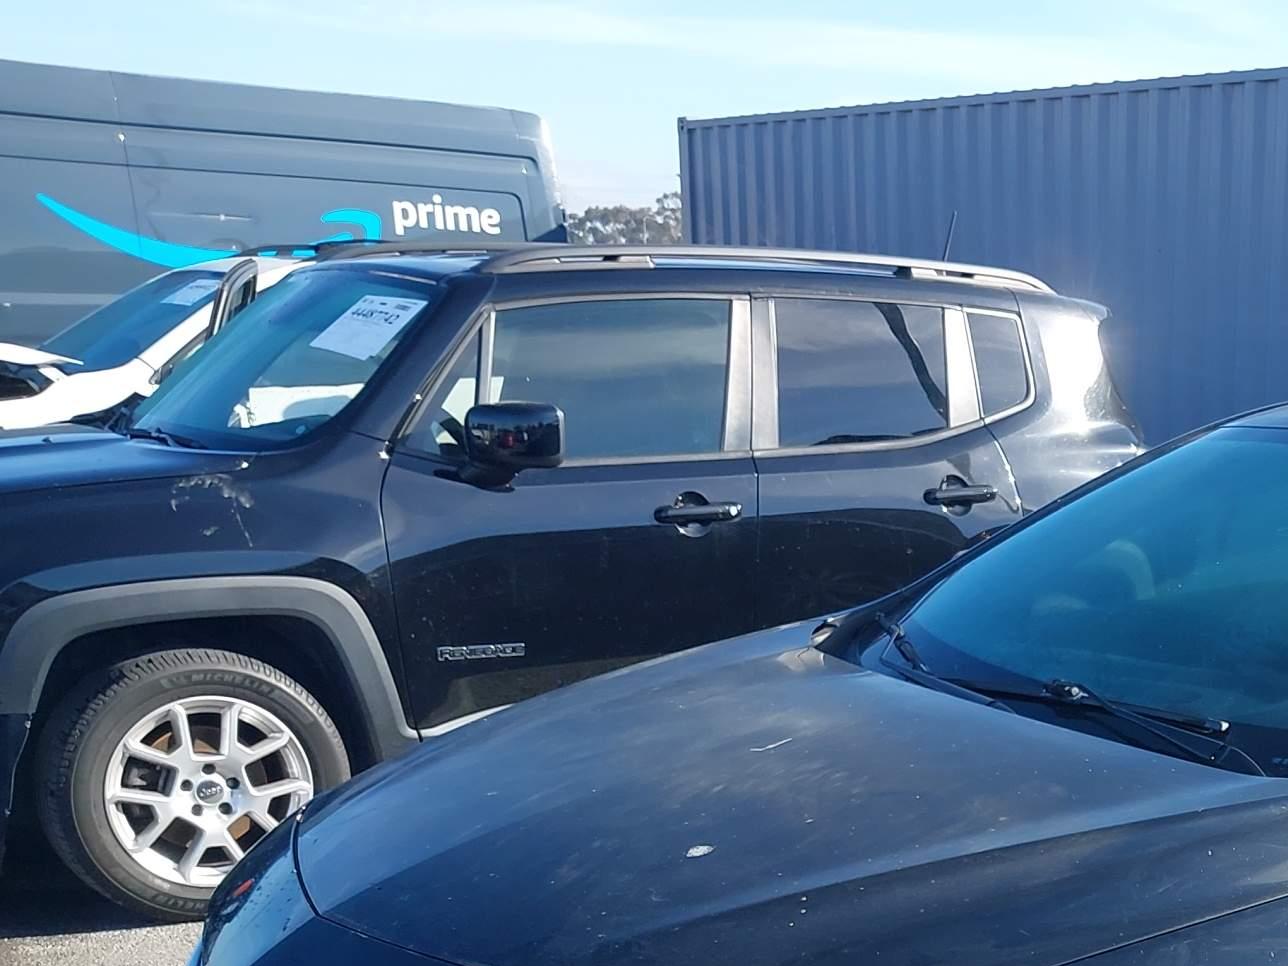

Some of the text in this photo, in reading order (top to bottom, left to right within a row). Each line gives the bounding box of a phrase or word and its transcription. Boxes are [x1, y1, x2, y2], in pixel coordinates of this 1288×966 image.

[392, 194, 501, 236] prime
[437, 643, 525, 661] RENEGADE
[192, 673, 276, 697] MICHELIN
